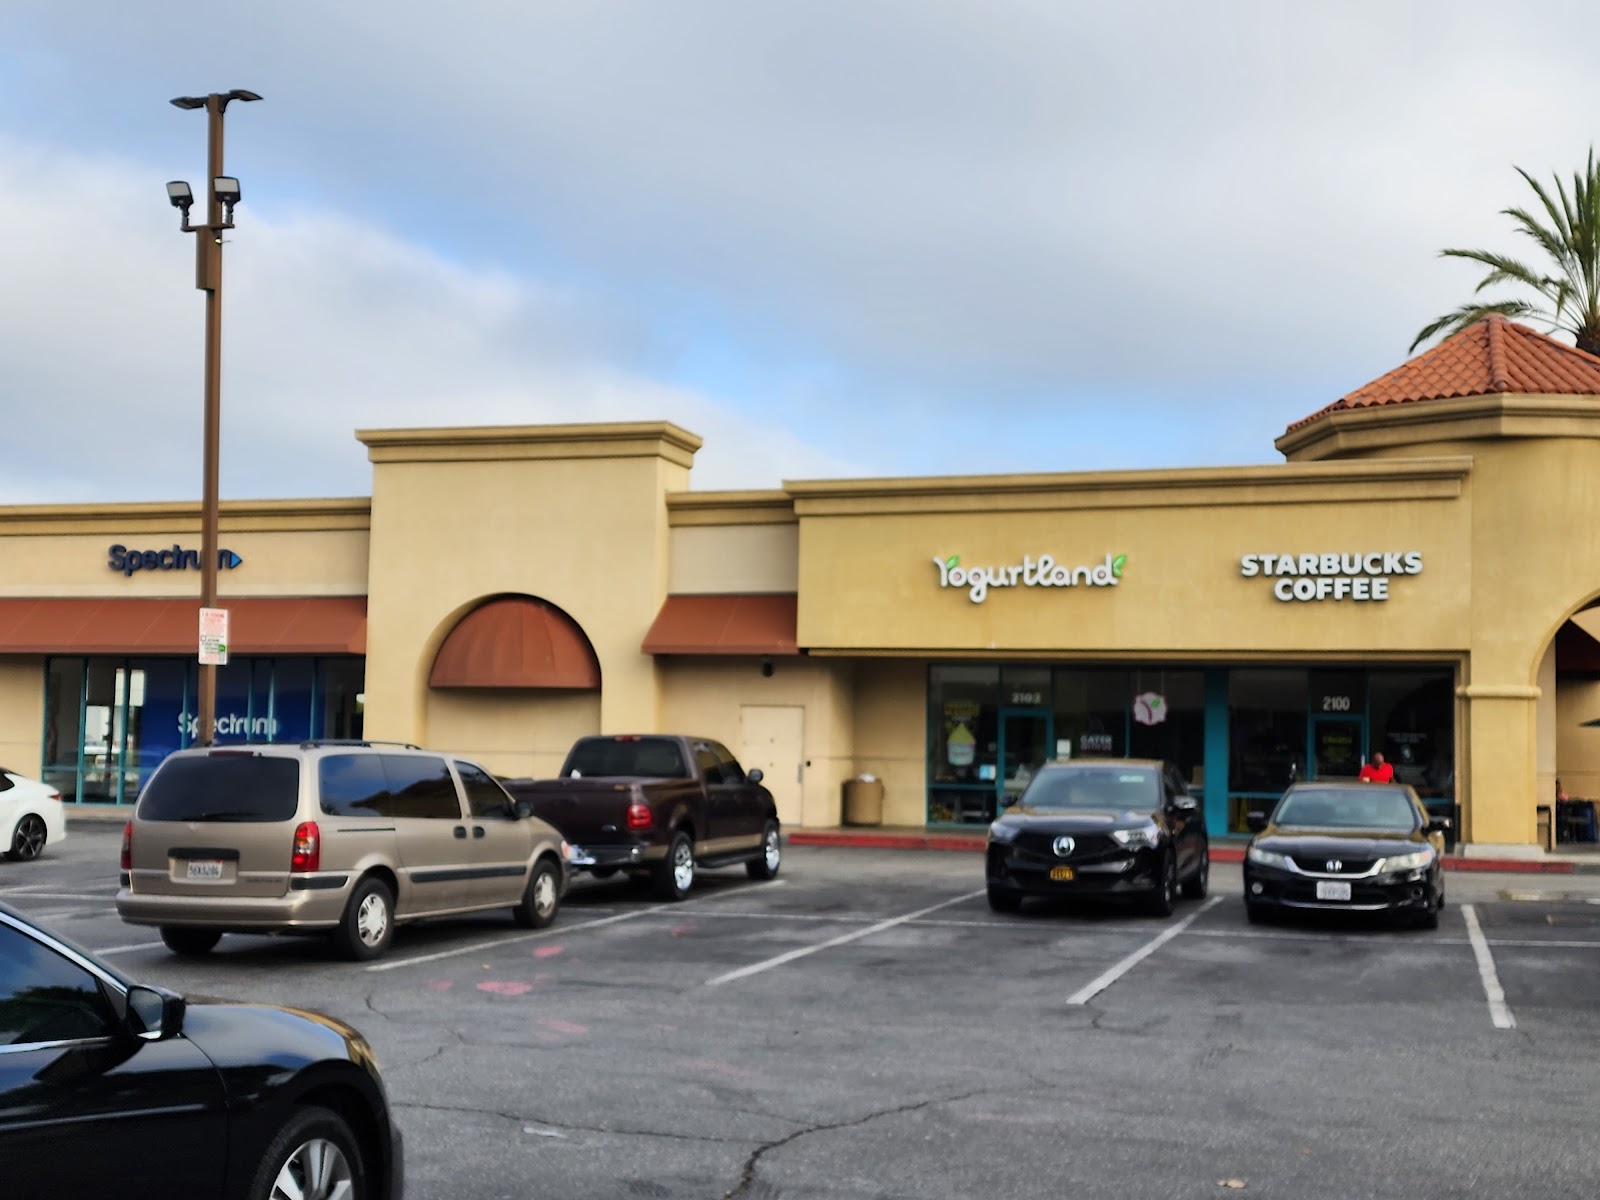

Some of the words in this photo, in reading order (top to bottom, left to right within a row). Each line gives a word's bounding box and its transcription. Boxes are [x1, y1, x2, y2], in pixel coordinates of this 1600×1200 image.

[1241, 551, 1424, 577] STARBUCKS
[933, 553, 1119, 604] Yogurtland
[1274, 577, 1390, 602] COFFEE
[1322, 695, 1351, 711] 2100
[177, 712, 277, 739] Spctrum
